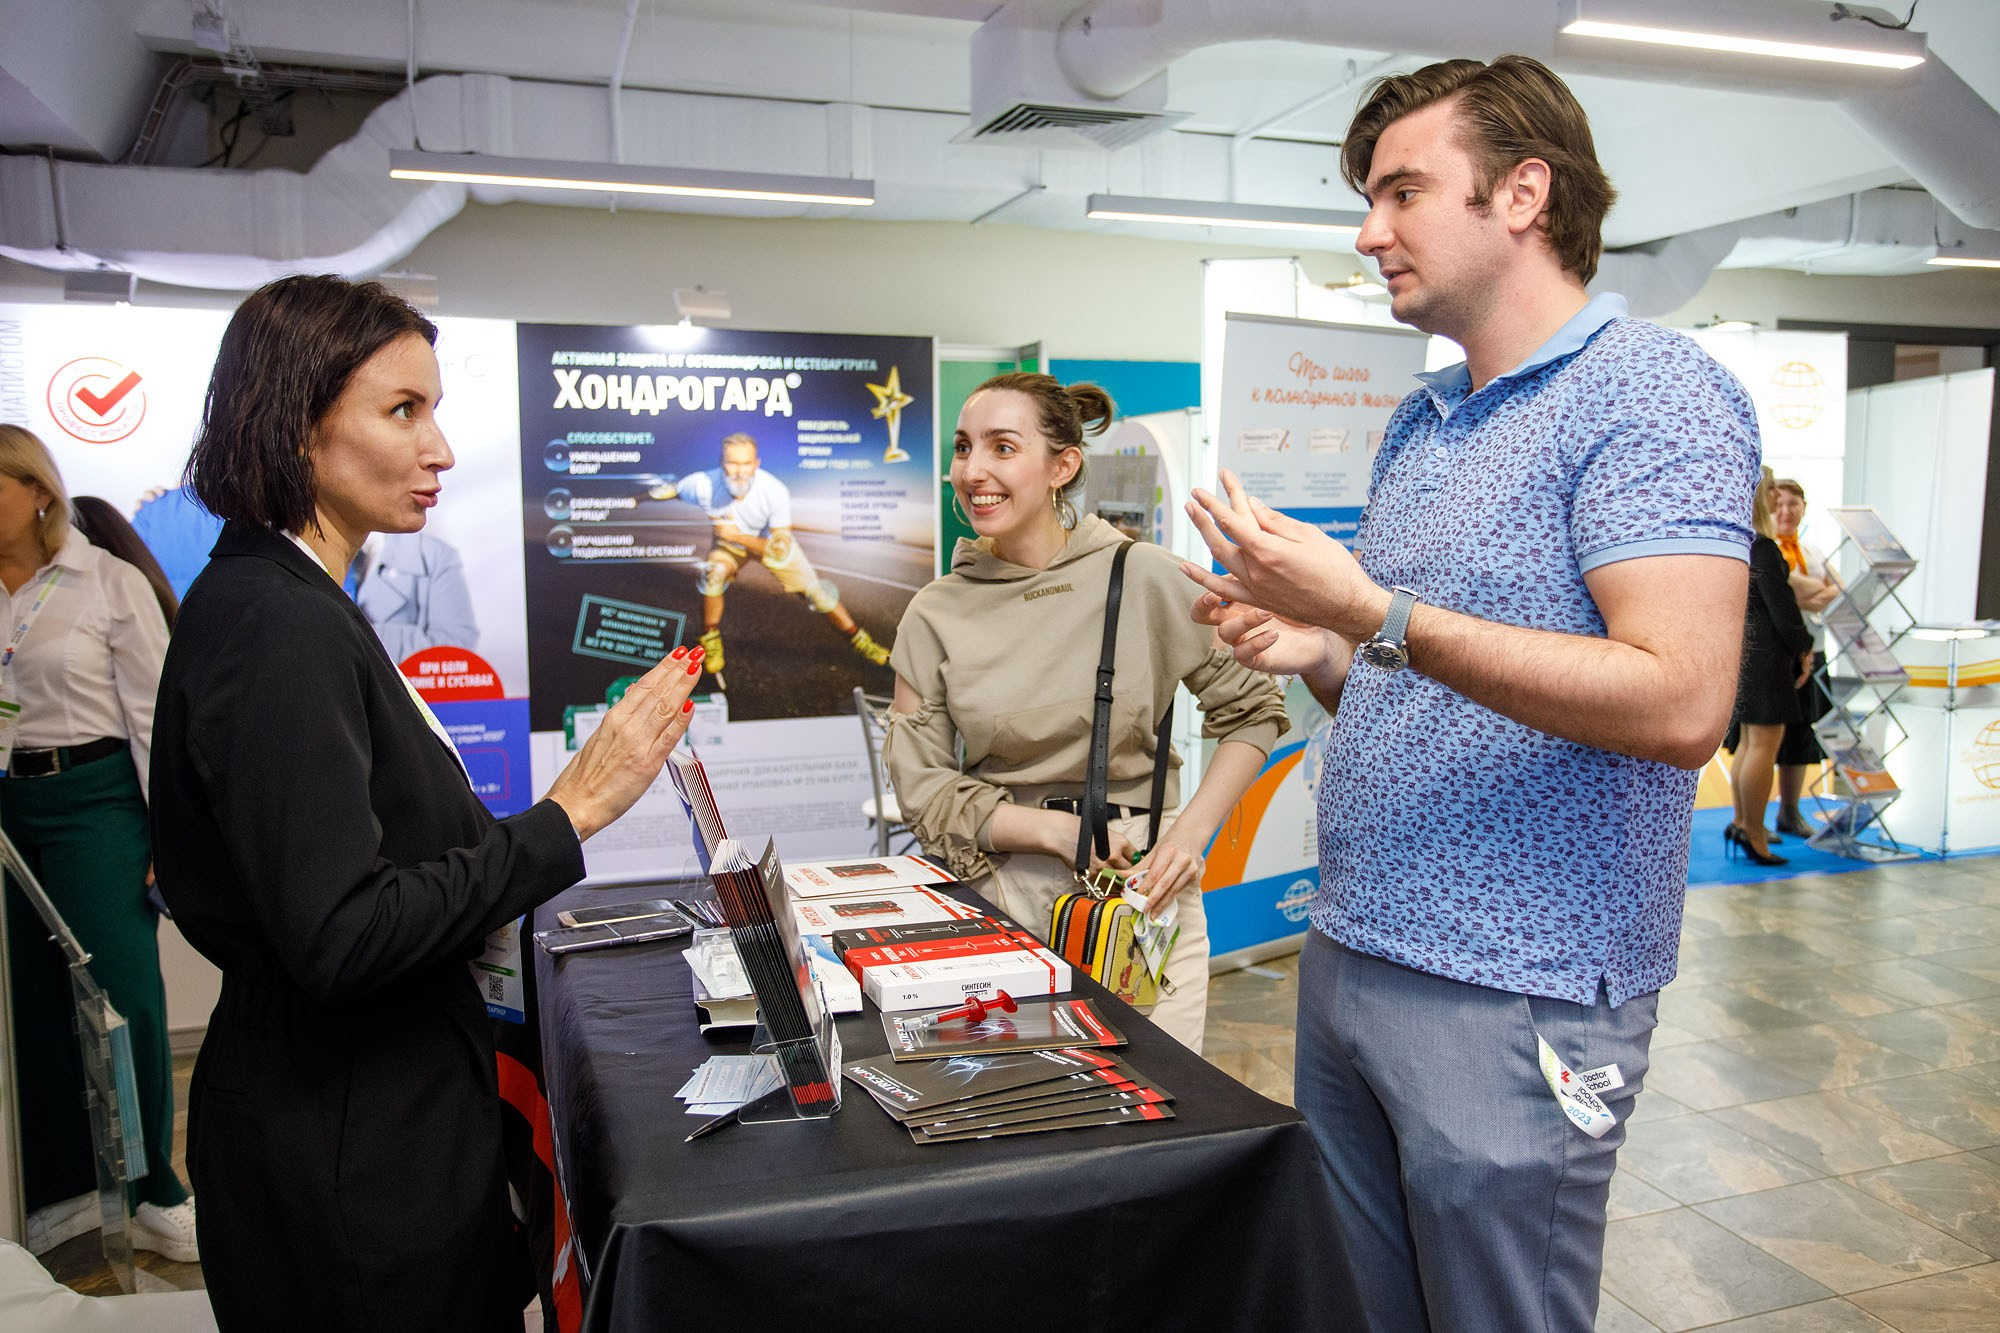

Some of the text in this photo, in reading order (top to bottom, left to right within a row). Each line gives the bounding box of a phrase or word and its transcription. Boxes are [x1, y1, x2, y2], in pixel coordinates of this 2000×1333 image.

[419, 661, 468, 675] ПРИ БОЛИ
[447, 674, 494, 688] СУСТАВАХ
[962, 982, 991, 991] СИНТЕСИН
[1583, 1071, 1607, 1083] Doctor
[1566, 1105, 1592, 1126] 2023
